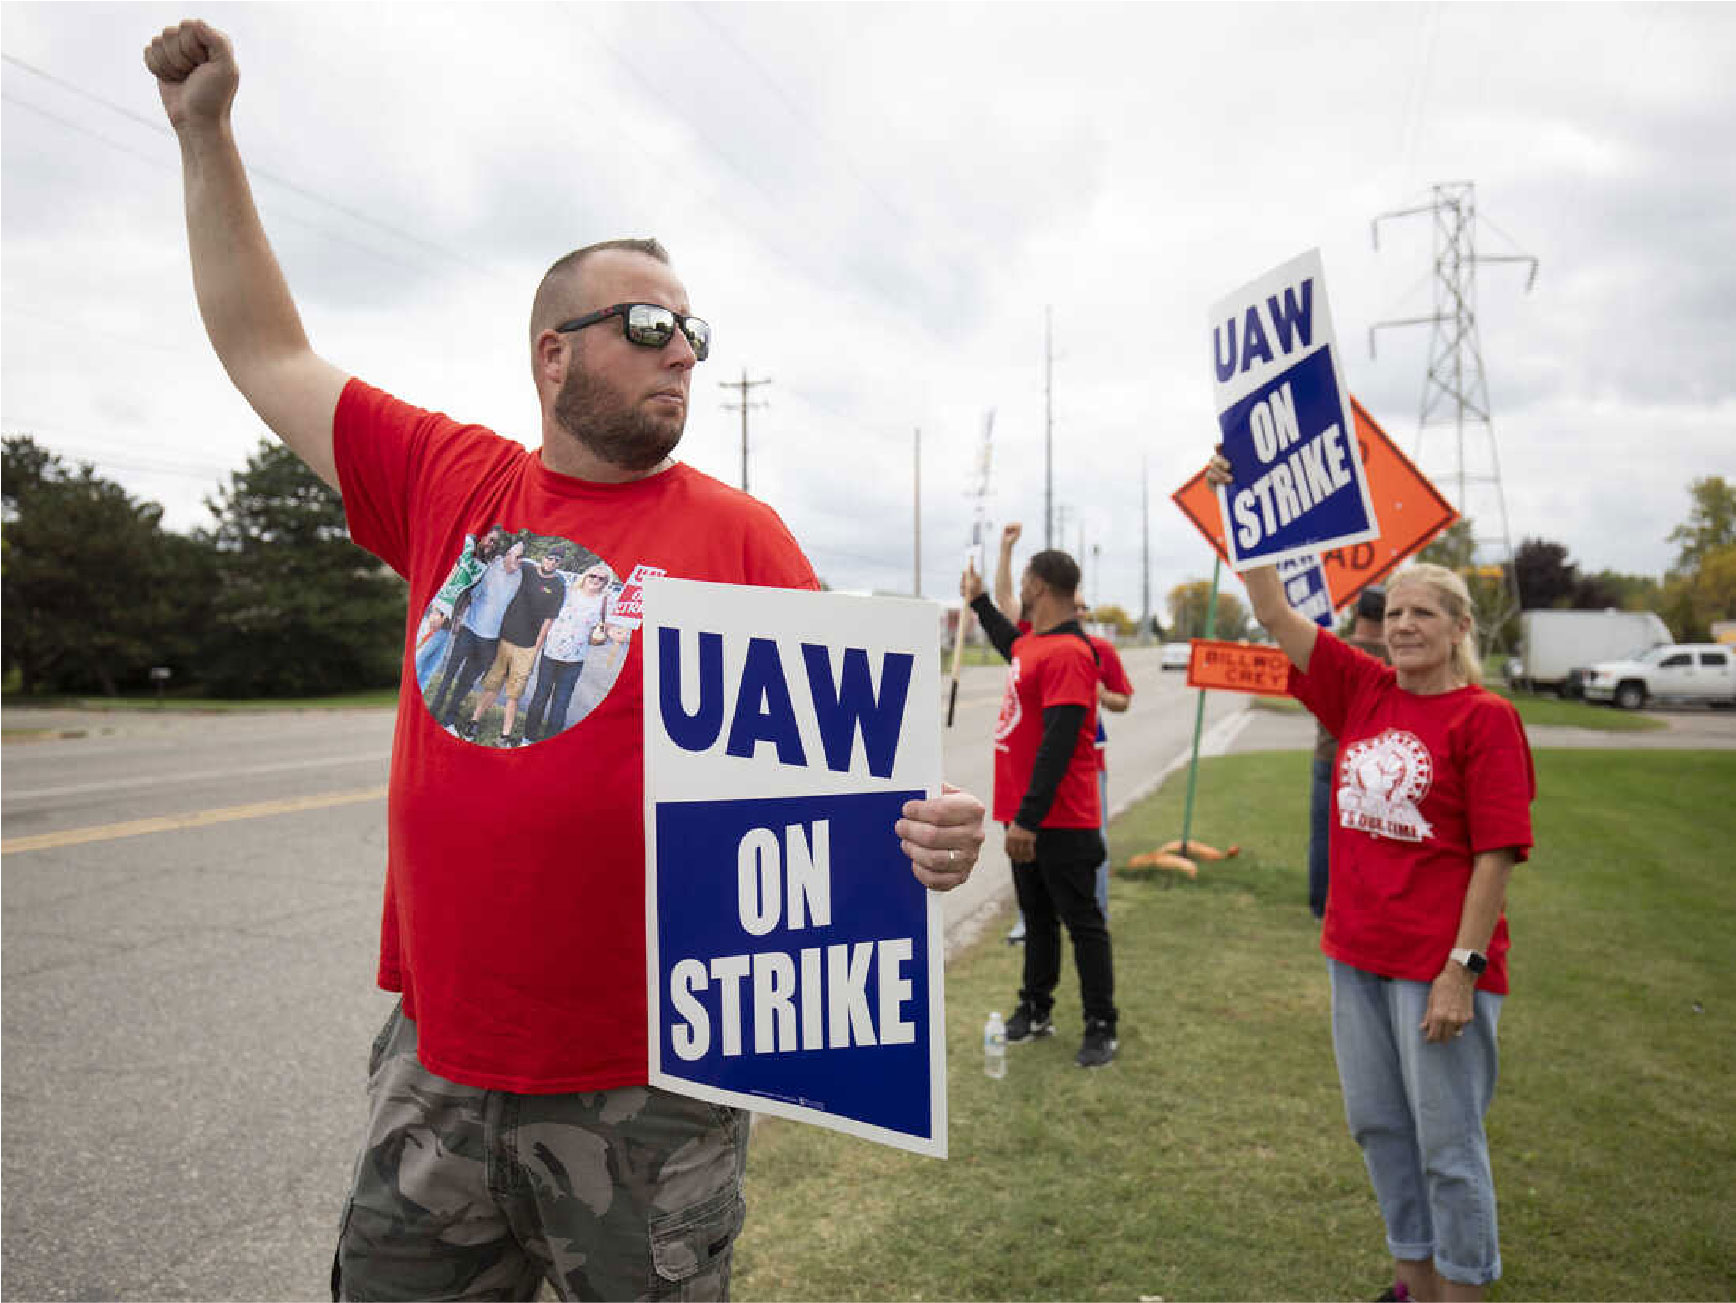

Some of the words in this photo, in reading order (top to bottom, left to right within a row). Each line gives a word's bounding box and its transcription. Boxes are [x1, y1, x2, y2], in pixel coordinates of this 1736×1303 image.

[1213, 277, 1314, 384] UAW
[1251, 381, 1300, 464] ON
[1234, 423, 1351, 550] STRIKE
[658, 626, 914, 780] UAW
[738, 819, 832, 936] ON
[670, 937, 917, 1062] STRIKE
